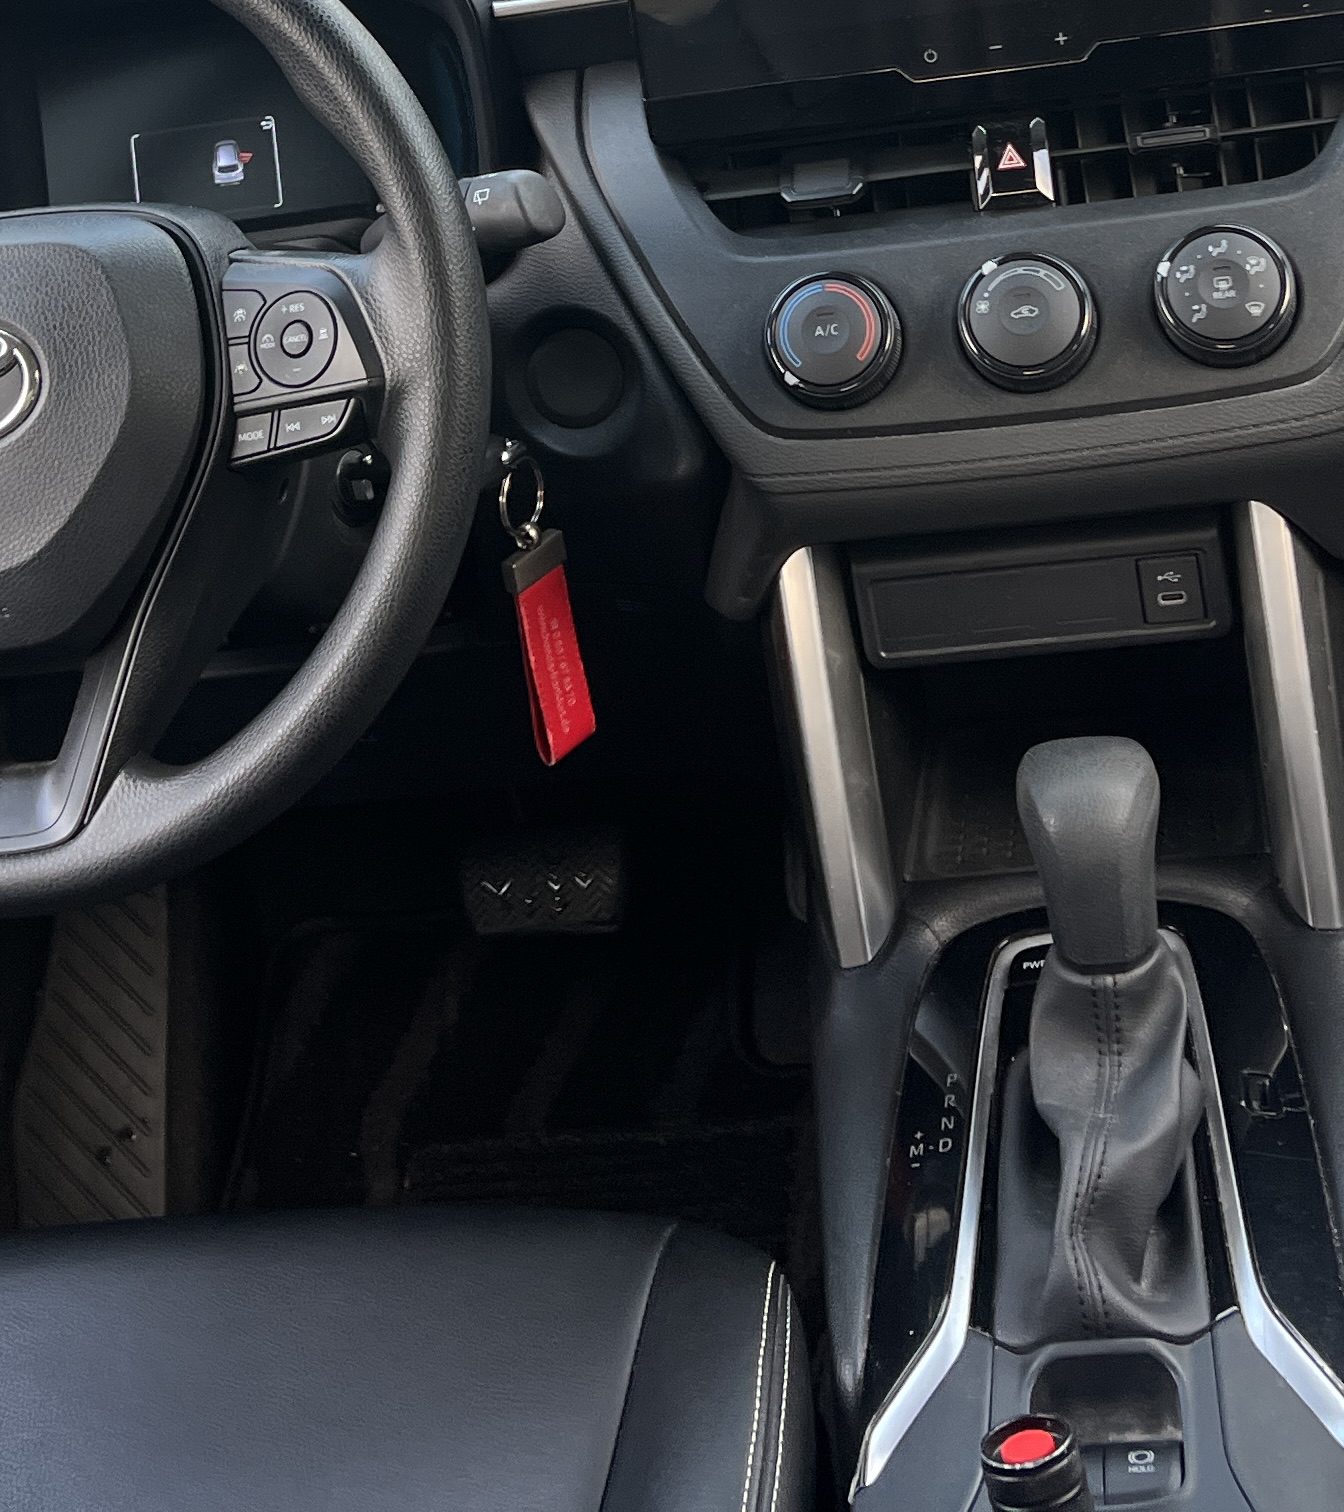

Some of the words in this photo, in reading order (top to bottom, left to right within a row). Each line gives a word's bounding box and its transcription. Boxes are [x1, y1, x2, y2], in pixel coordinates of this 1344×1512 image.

[814, 323, 839, 337] A/C
[238, 429, 264, 442] MODE
[944, 1094, 957, 1108] R
[941, 1115, 955, 1131] N
